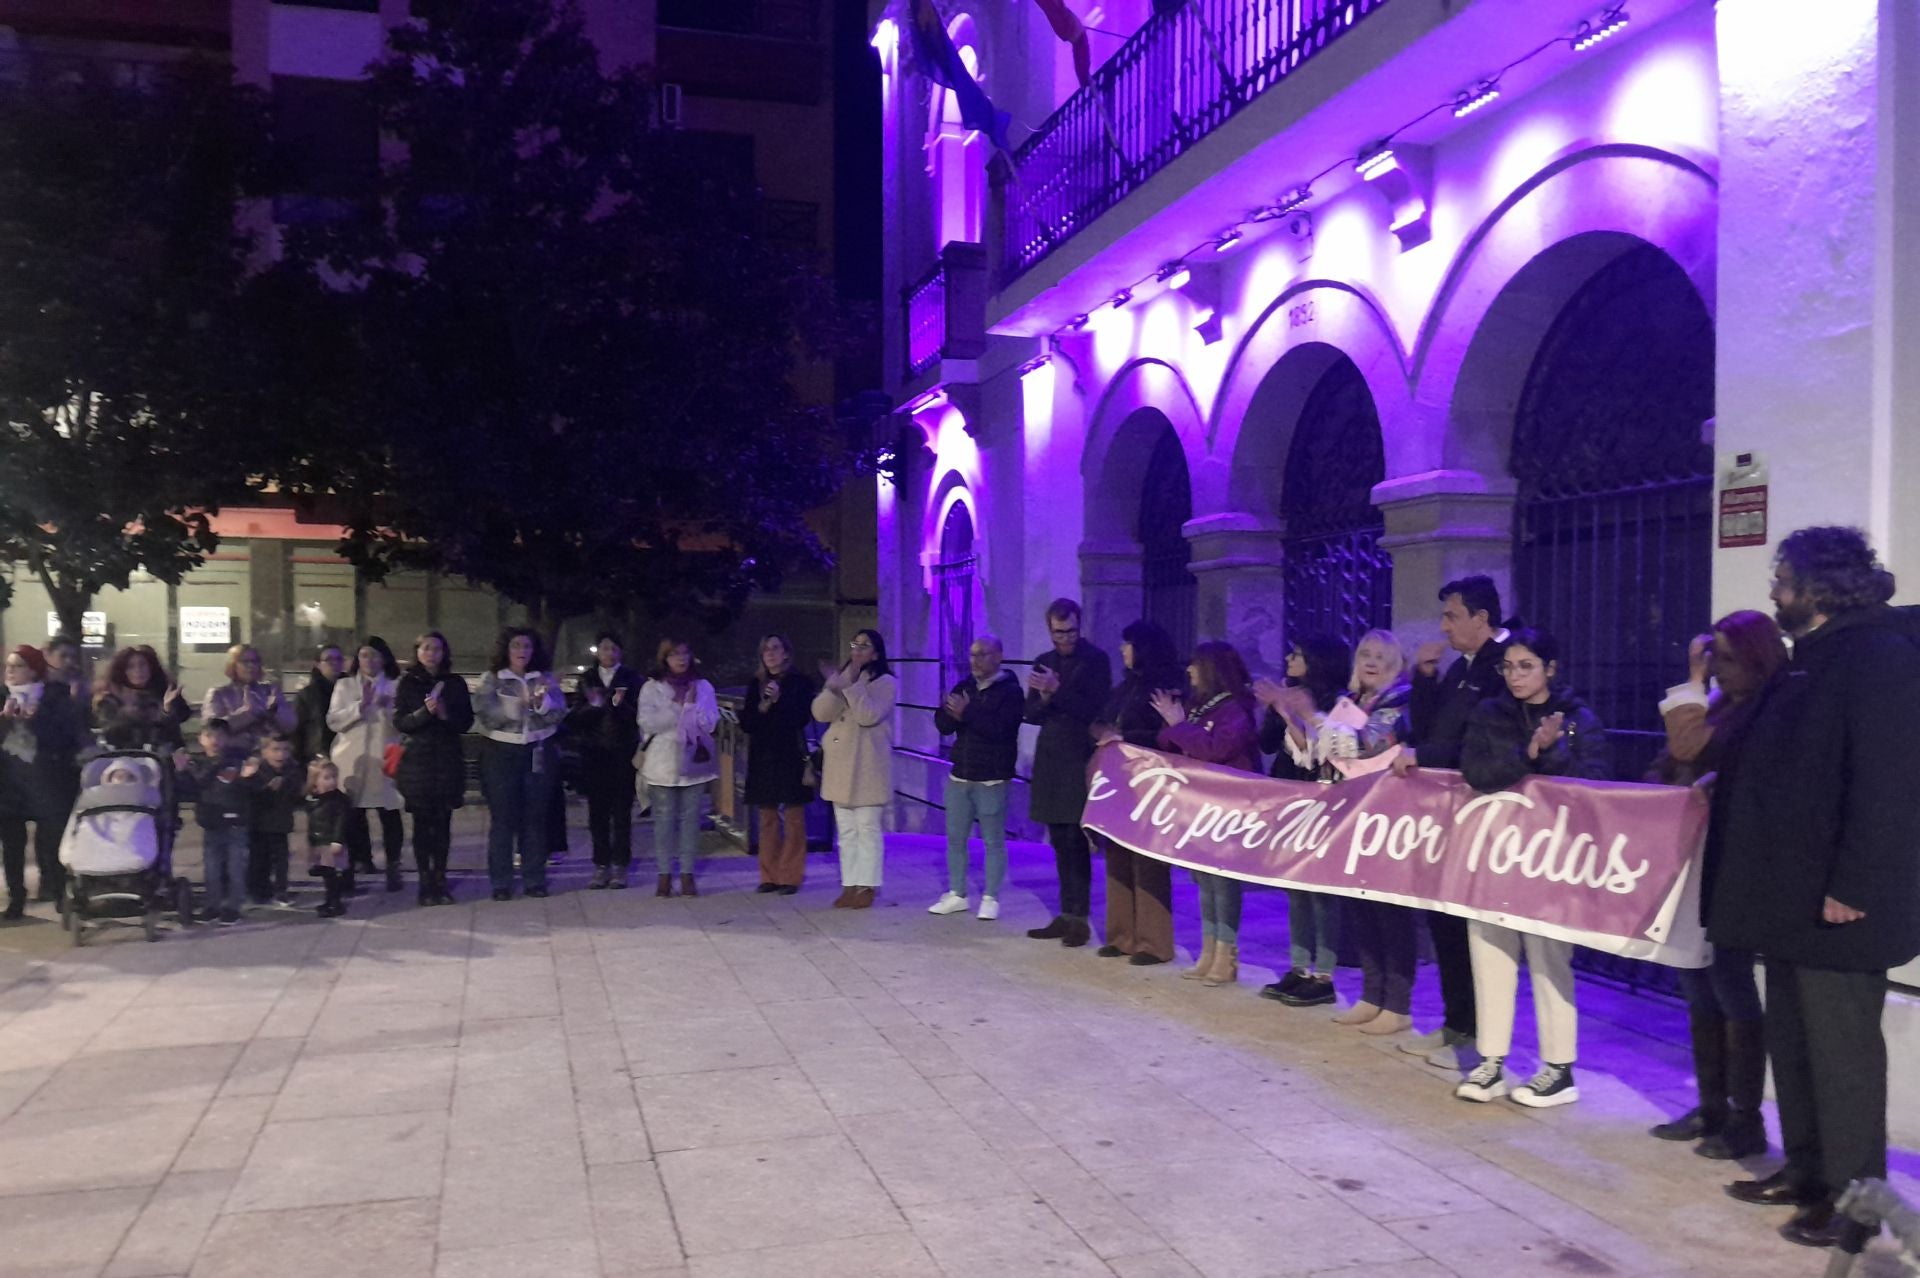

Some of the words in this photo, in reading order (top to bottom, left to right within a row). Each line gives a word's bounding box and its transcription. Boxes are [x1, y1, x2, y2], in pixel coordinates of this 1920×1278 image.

[1129, 767, 1189, 834] Ti,
[1174, 801, 1272, 850] por
[1344, 811, 1447, 875] por
[1454, 790, 1649, 894] Todas
